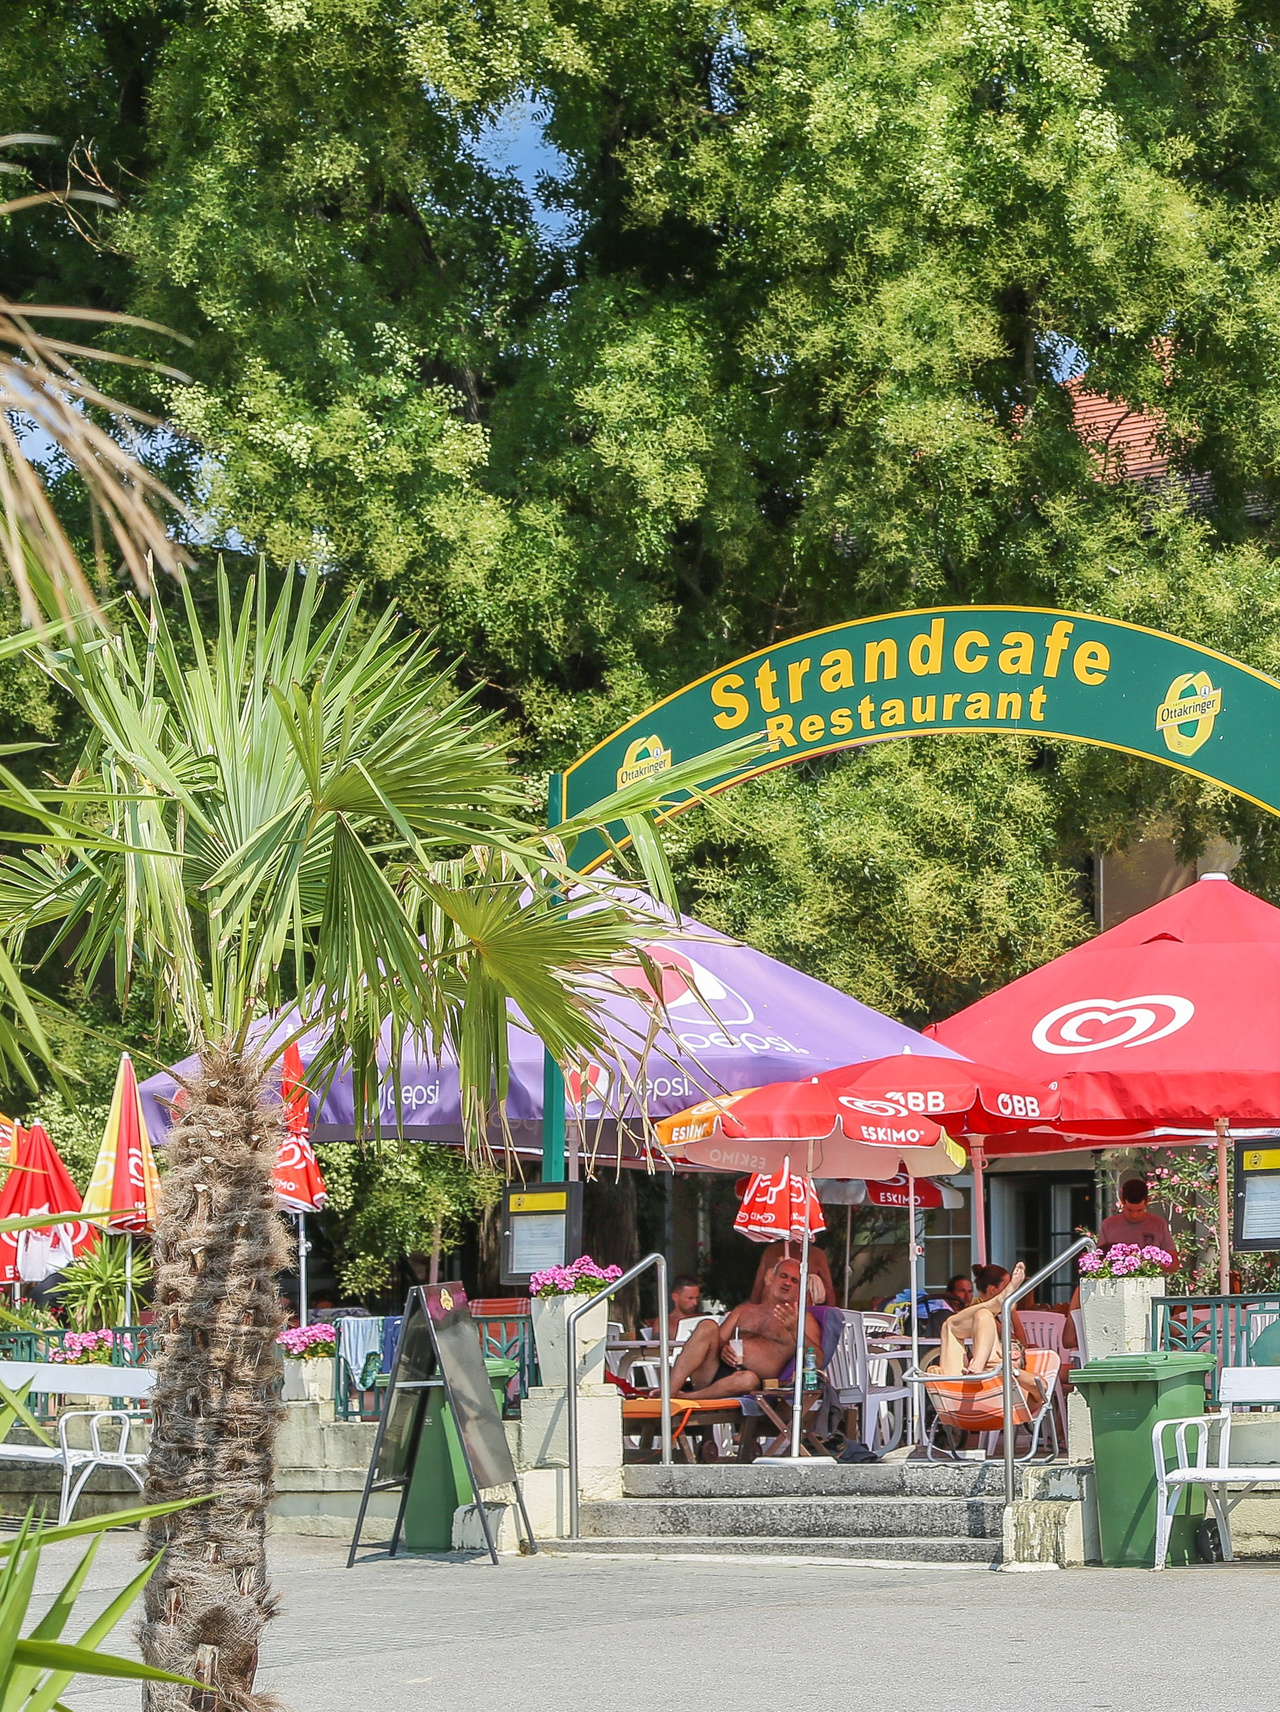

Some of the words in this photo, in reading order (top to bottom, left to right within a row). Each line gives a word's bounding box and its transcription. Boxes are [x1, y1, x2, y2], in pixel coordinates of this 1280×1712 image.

[710, 617, 1111, 730] Strandcafe
[765, 684, 1048, 752] Restaurant
[1161, 699, 1216, 722] Ottakringer
[620, 758, 667, 783] Ottakringer
[678, 1031, 803, 1054] pepsi
[997, 1093, 1040, 1117] ÖBB
[860, 1125, 920, 1143] ESKIMO
[880, 1192, 922, 1206] ESKIMO
